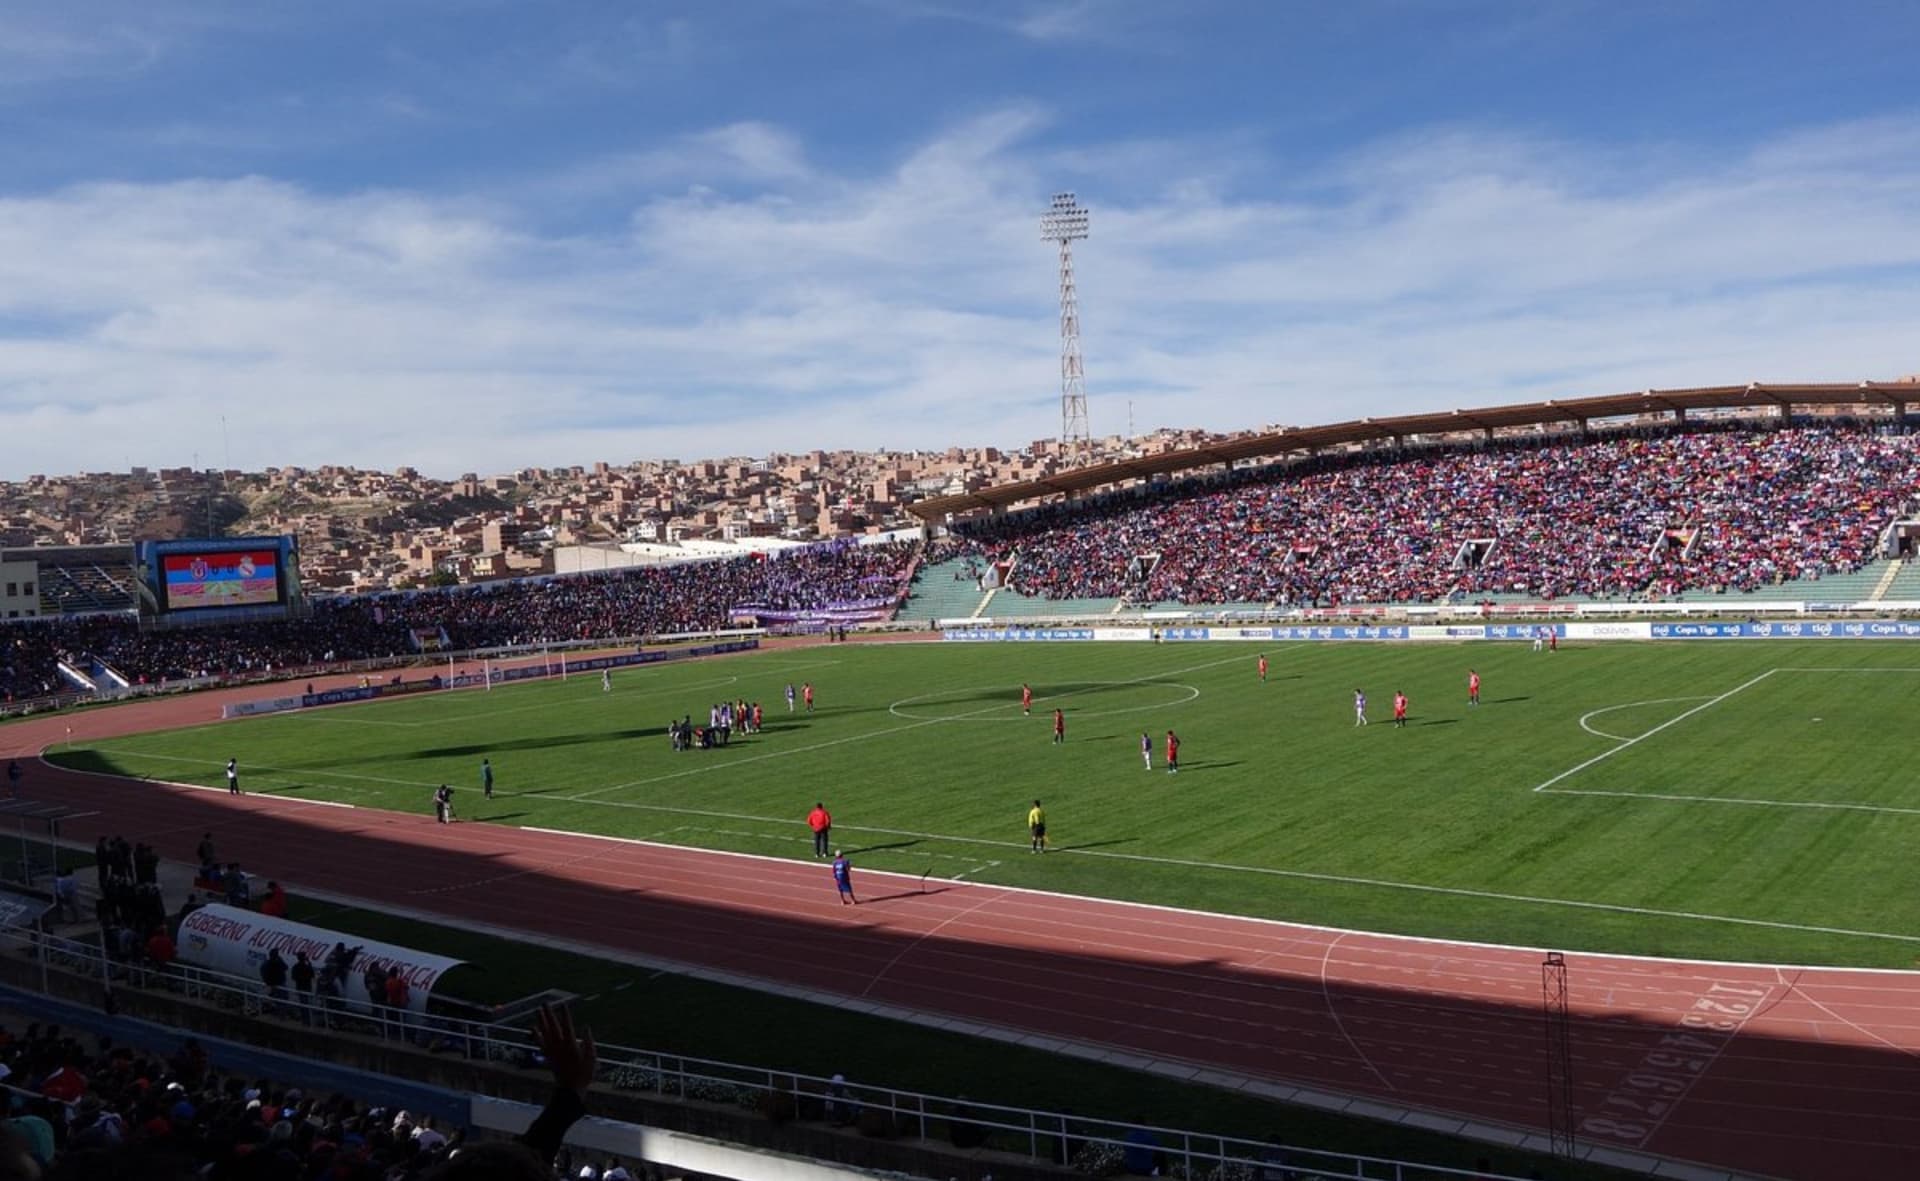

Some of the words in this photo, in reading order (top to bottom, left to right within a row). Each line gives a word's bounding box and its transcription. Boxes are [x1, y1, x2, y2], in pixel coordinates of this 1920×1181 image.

[1675, 625, 1697, 635] Copa
[1871, 623, 1897, 635] Copa
[185, 912, 251, 944] GOBIERNO
[1710, 983, 1763, 996] 1
[1695, 997, 1749, 1014] 2
[1679, 1014, 1736, 1031] 3
[1583, 1118, 1647, 1138] 8
